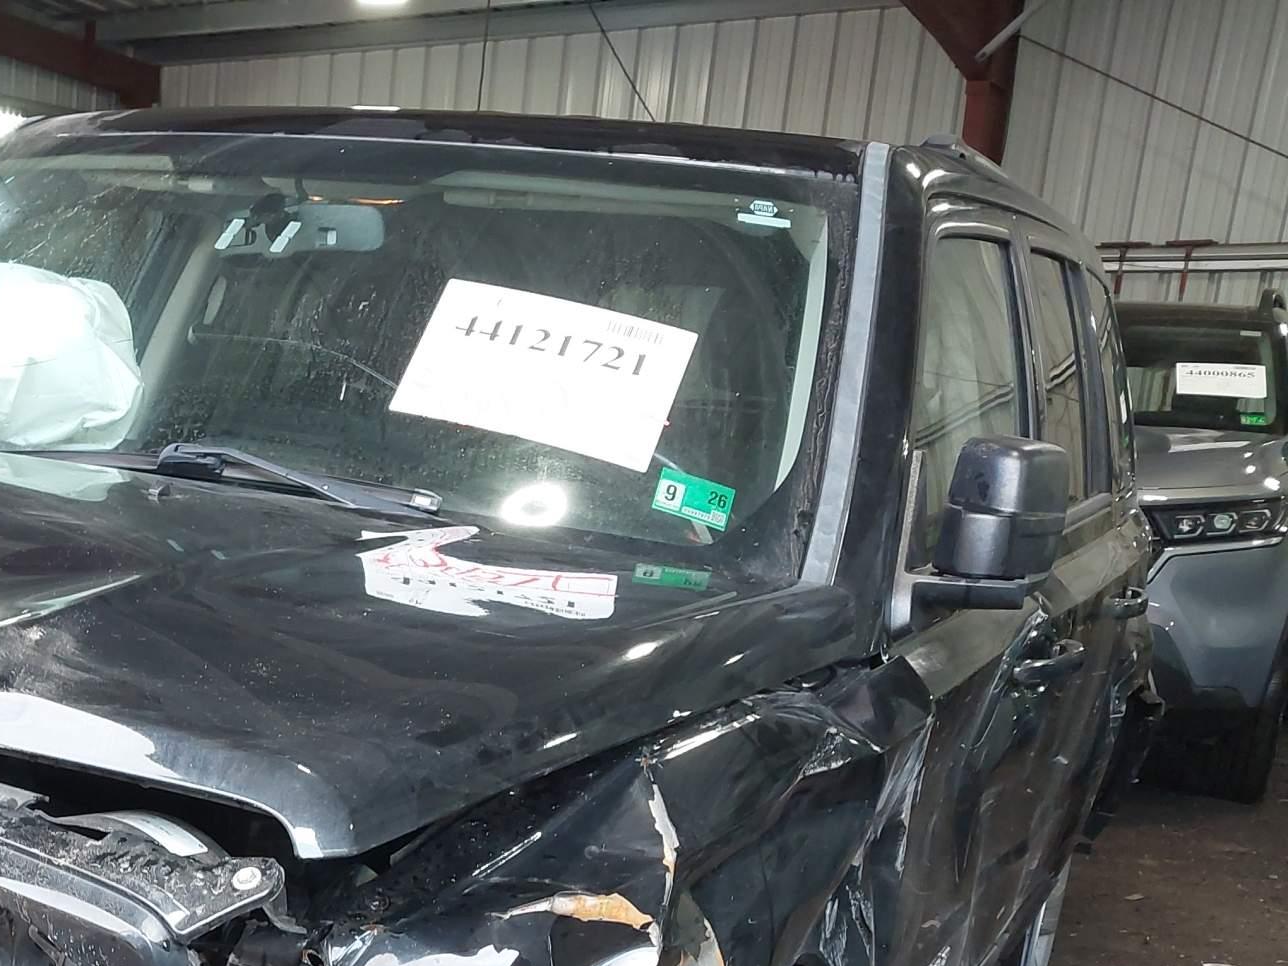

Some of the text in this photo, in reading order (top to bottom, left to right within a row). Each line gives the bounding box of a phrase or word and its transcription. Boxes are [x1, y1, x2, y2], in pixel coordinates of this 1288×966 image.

[455, 314, 647, 376] 44121721
[664, 484, 729, 509] 9 26
